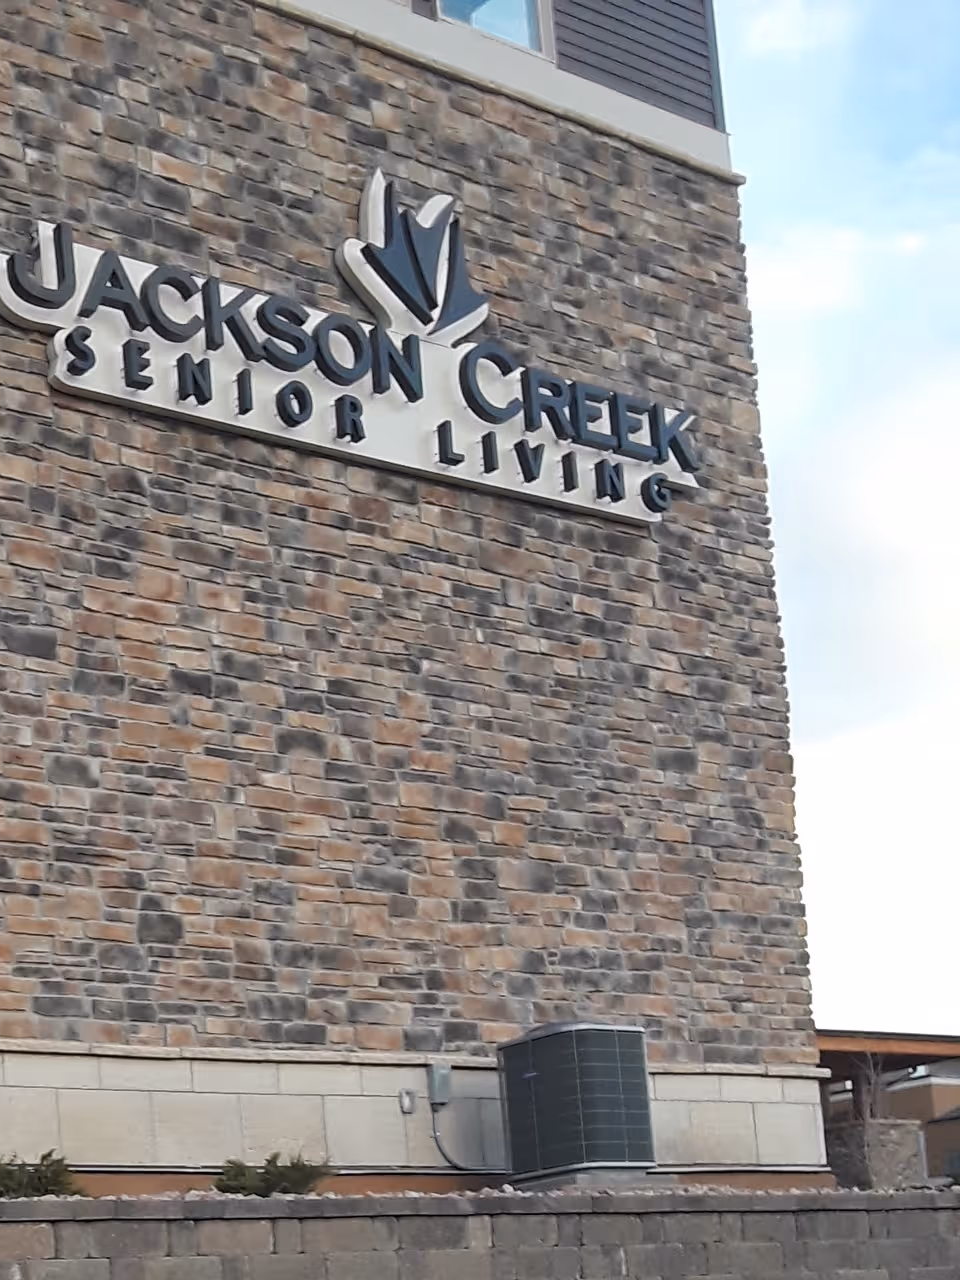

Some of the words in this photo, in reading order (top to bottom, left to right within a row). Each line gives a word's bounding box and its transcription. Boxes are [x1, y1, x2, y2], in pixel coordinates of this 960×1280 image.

[6, 220, 424, 403] JACKSON
[459, 340, 702, 475] CREEK
[65, 325, 366, 443] SENIOR
[437, 419, 674, 513] LIVING
